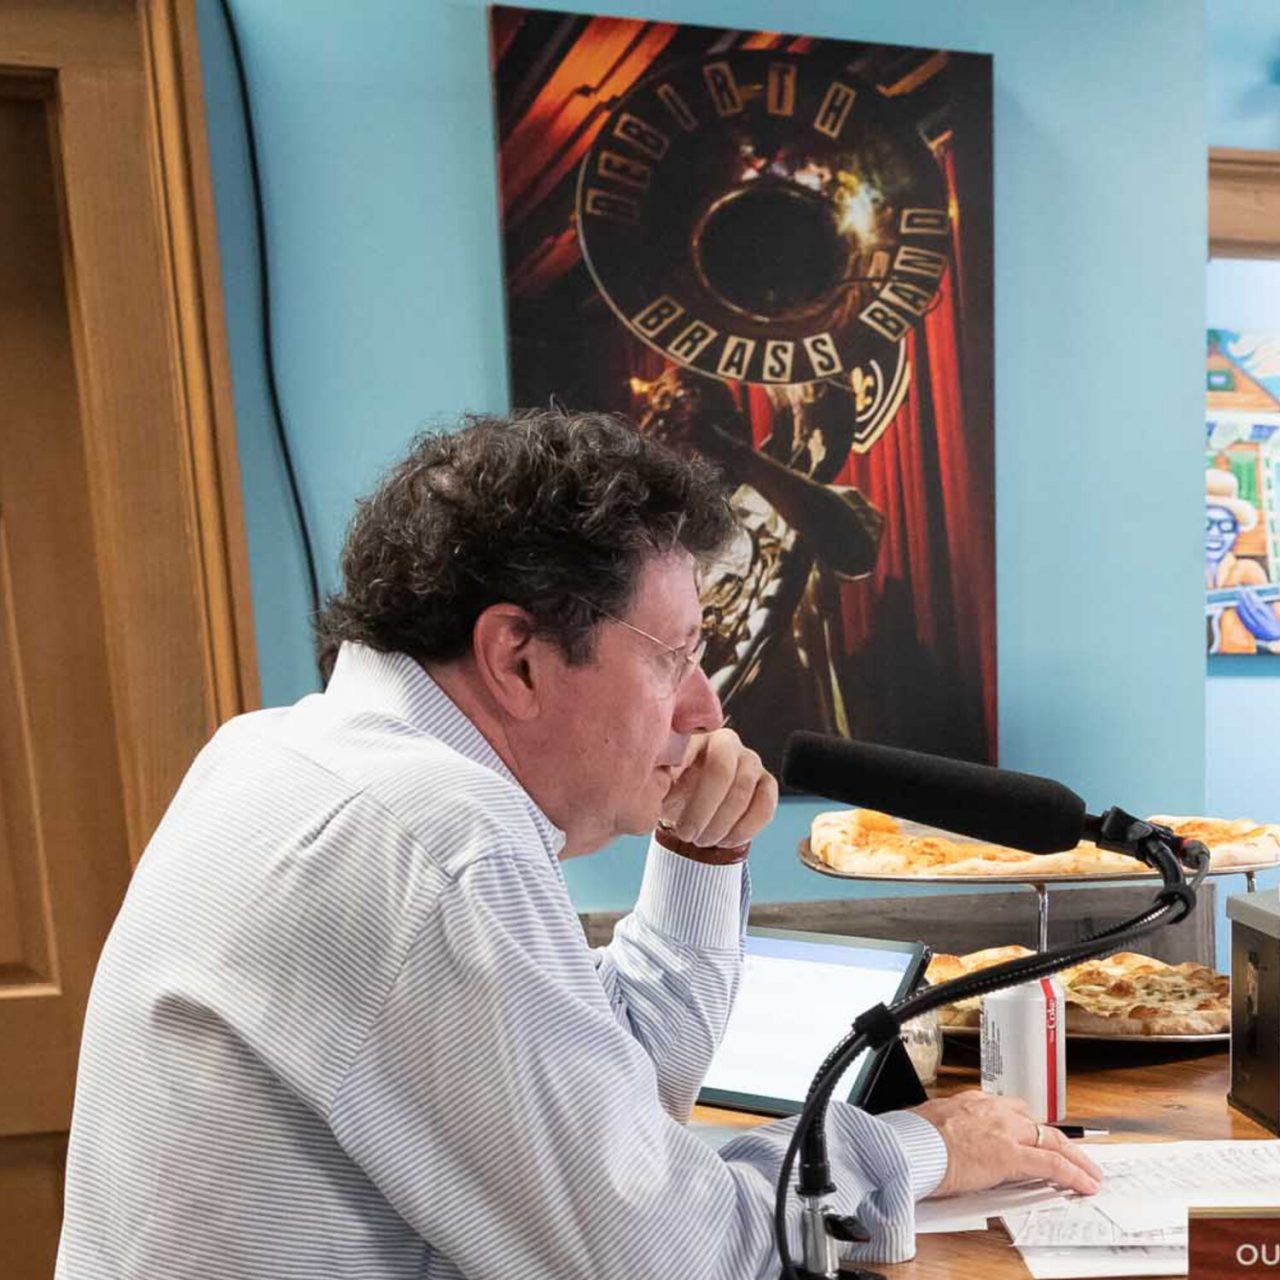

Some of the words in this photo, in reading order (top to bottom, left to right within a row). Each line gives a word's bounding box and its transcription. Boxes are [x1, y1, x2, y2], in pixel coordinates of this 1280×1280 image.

[586, 60, 856, 224] REBIRTH
[632, 297, 843, 382] BRASS
[859, 208, 949, 343] BAND
